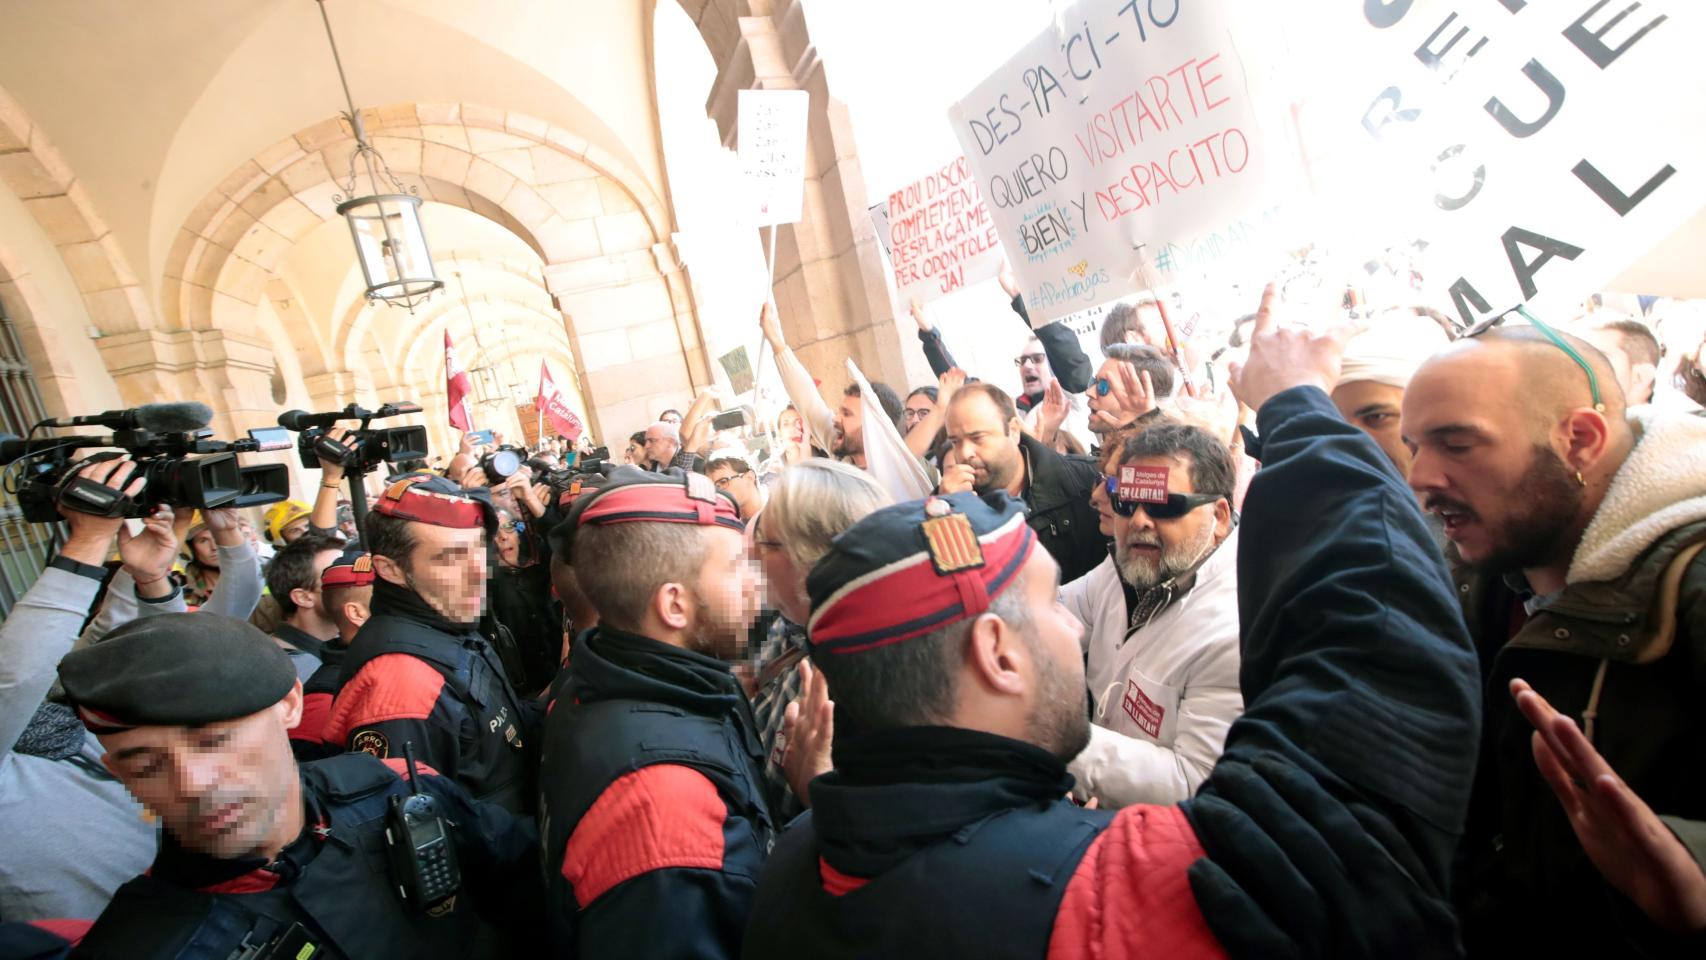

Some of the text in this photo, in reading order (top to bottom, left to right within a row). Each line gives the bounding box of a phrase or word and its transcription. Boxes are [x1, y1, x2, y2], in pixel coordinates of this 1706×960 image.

[990, 53, 1231, 208] QUIERO VISITARTE
[889, 181, 921, 218] PROU
[1020, 127, 1249, 255] BIEN Y DESPACITO
[895, 225, 999, 289] PER ODONTOLE
[939, 265, 965, 293] JA!
[1120, 486, 1130, 498] EN
